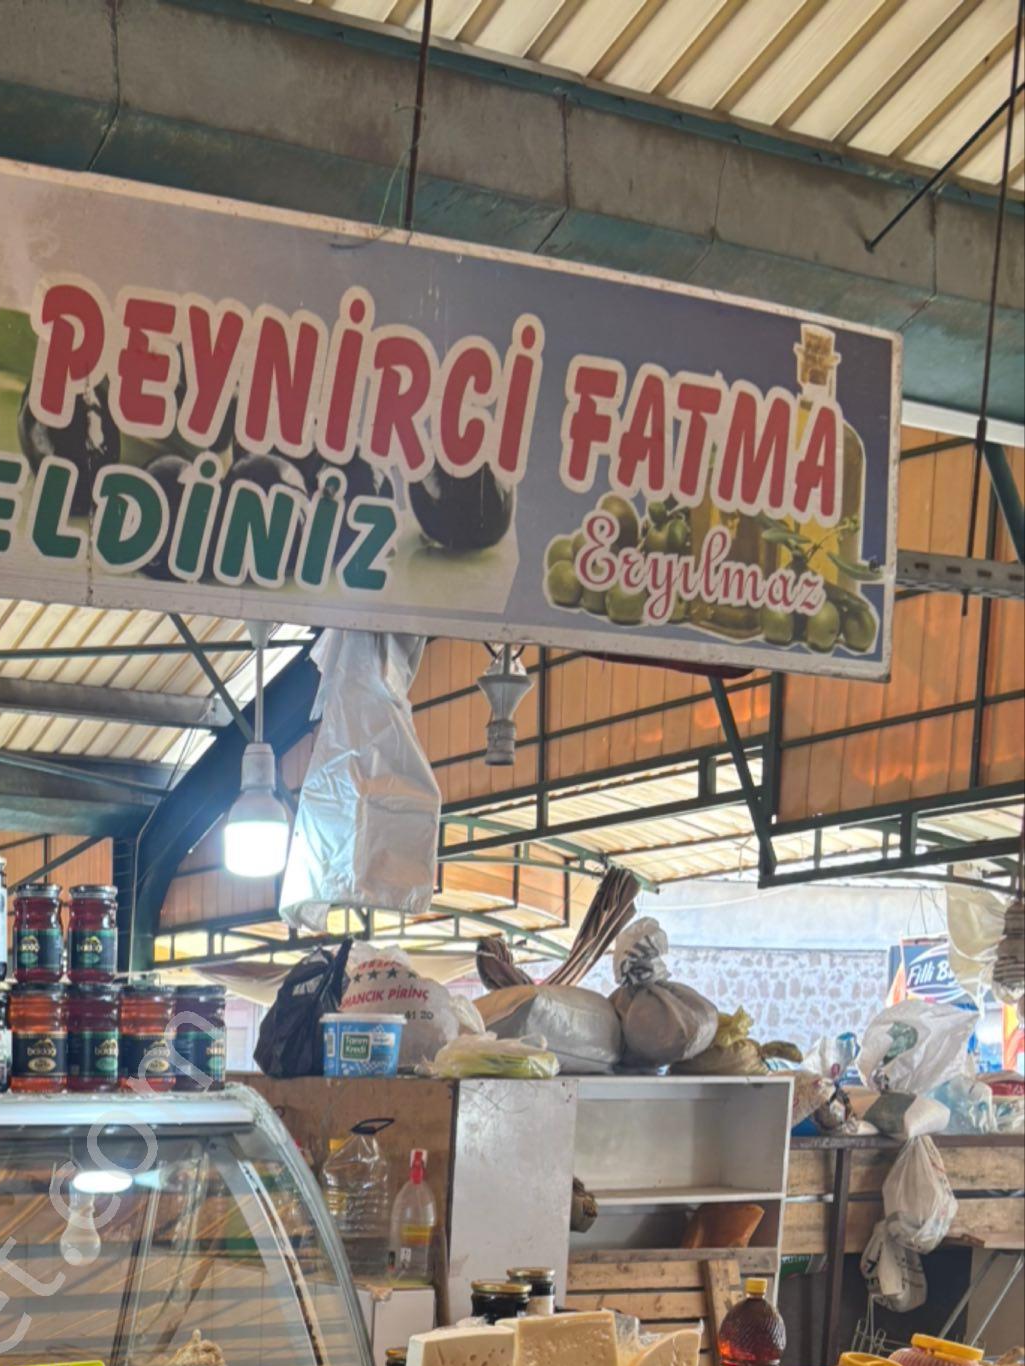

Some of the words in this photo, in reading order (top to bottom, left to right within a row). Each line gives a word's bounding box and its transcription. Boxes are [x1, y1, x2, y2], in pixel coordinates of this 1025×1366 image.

[39, 284, 538, 477] PEYNİRCİ
[567, 366, 843, 519] FATMA
[579, 515, 825, 620] Eryılmaz
